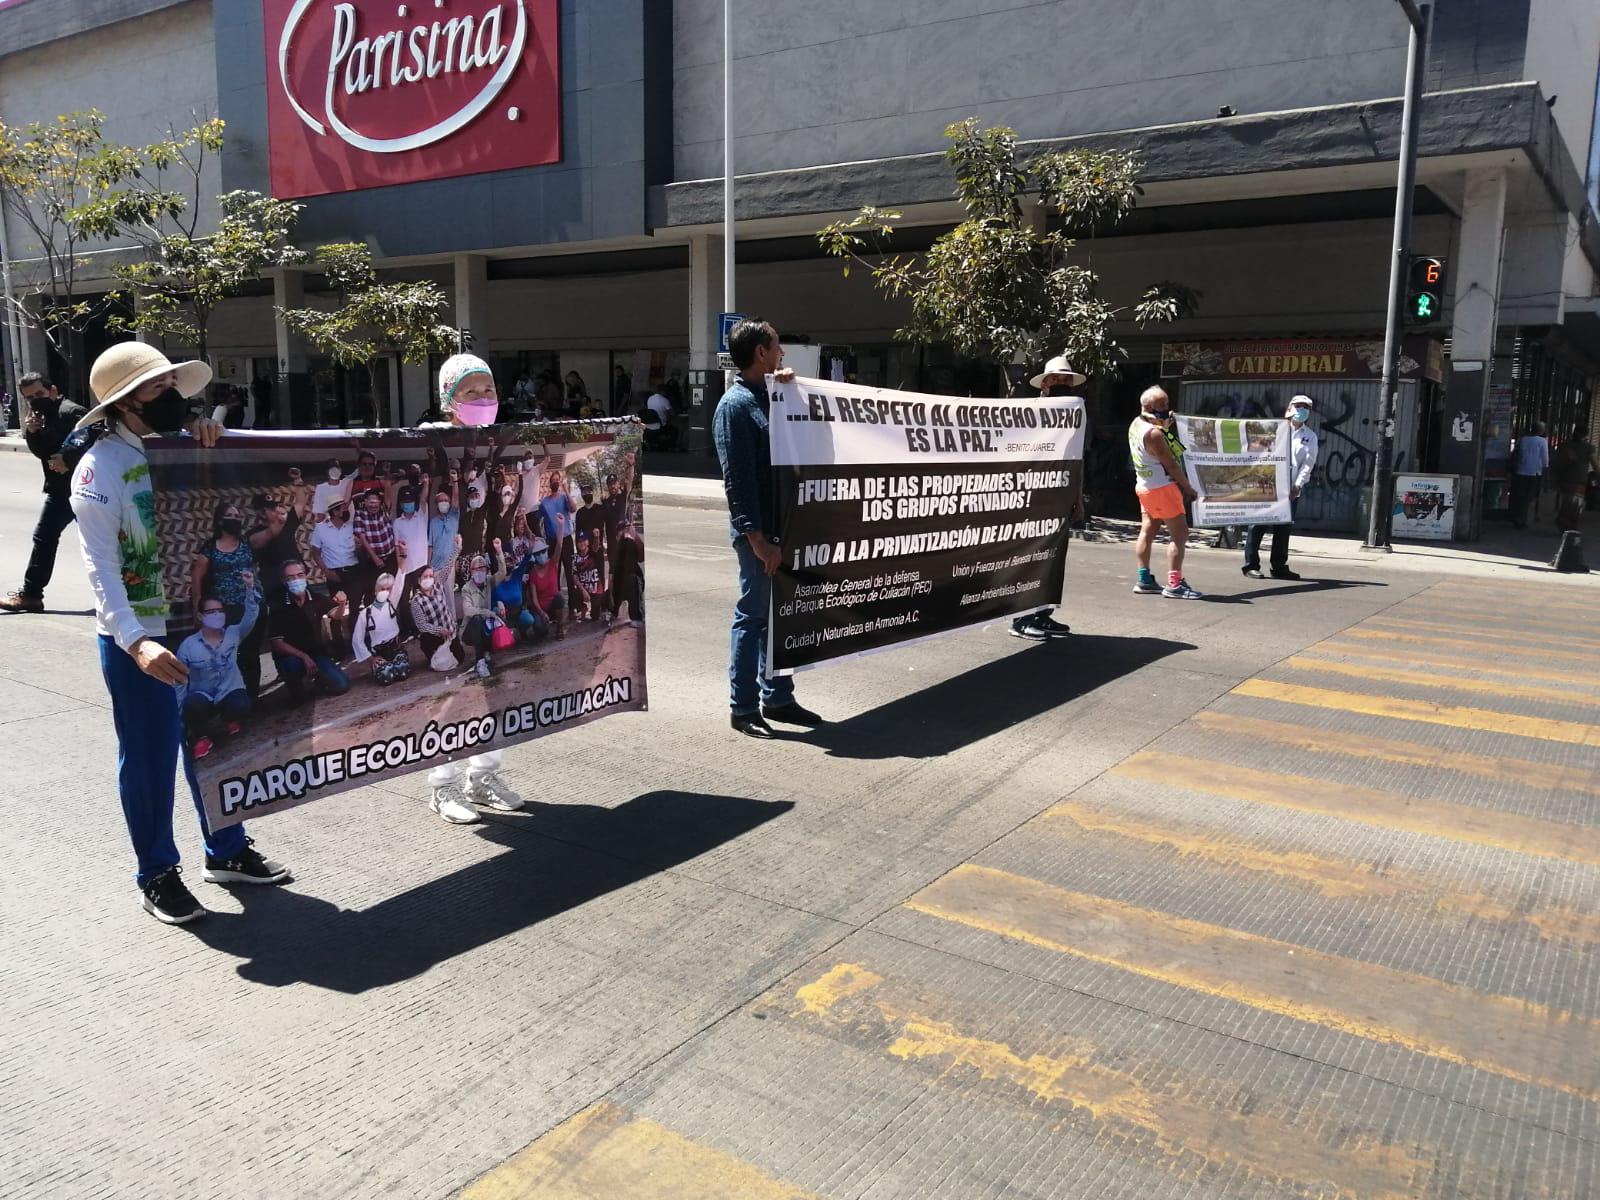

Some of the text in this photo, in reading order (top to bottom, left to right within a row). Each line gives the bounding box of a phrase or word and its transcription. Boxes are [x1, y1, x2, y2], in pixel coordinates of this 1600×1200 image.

[327, 0, 508, 95] Parisina
[1427, 264, 1440, 283] 6
[1228, 354, 1347, 374] CATEDRAL
[839, 396, 927, 426] RESPETO
[930, 404, 954, 427] AL
[956, 405, 1037, 429] DERECHO
[1039, 407, 1083, 430] AJENO
[905, 427, 930, 453] ES
[933, 428, 957, 453] LA
[864, 474, 891, 500] DE
[891, 474, 919, 498] LAS
[921, 472, 1014, 495] PROPIEDADES
[1015, 470, 1071, 489] PÚBLICAS
[862, 491, 1032, 523] LOS GRUPOS PRIVADOS!
[804, 545, 830, 567] NO
[832, 545, 845, 563] A
[848, 541, 869, 562] LA
[872, 525, 980, 556] PRIVATIZACIÓN
[981, 525, 998, 543] DE
[998, 524, 1012, 541] LO
[794, 569, 920, 598] Asamblea General de la defensa
[952, 563, 971, 578] Unión
[975, 561, 995, 574] Fuerza
[994, 560, 1005, 573] por
[779, 580, 933, 617] del Parque Ecológico de Culiacán (PEC)
[960, 592, 982, 606] Alianza
[785, 631, 815, 650] Ciudad
[815, 632, 822, 645] y
[822, 623, 864, 642] Naturaleza
[865, 621, 875, 633] en
[905, 610, 920, 625] A.C.
[221, 676, 631, 817] PARQUE ECOLÓGICO DE CULIACÁN
